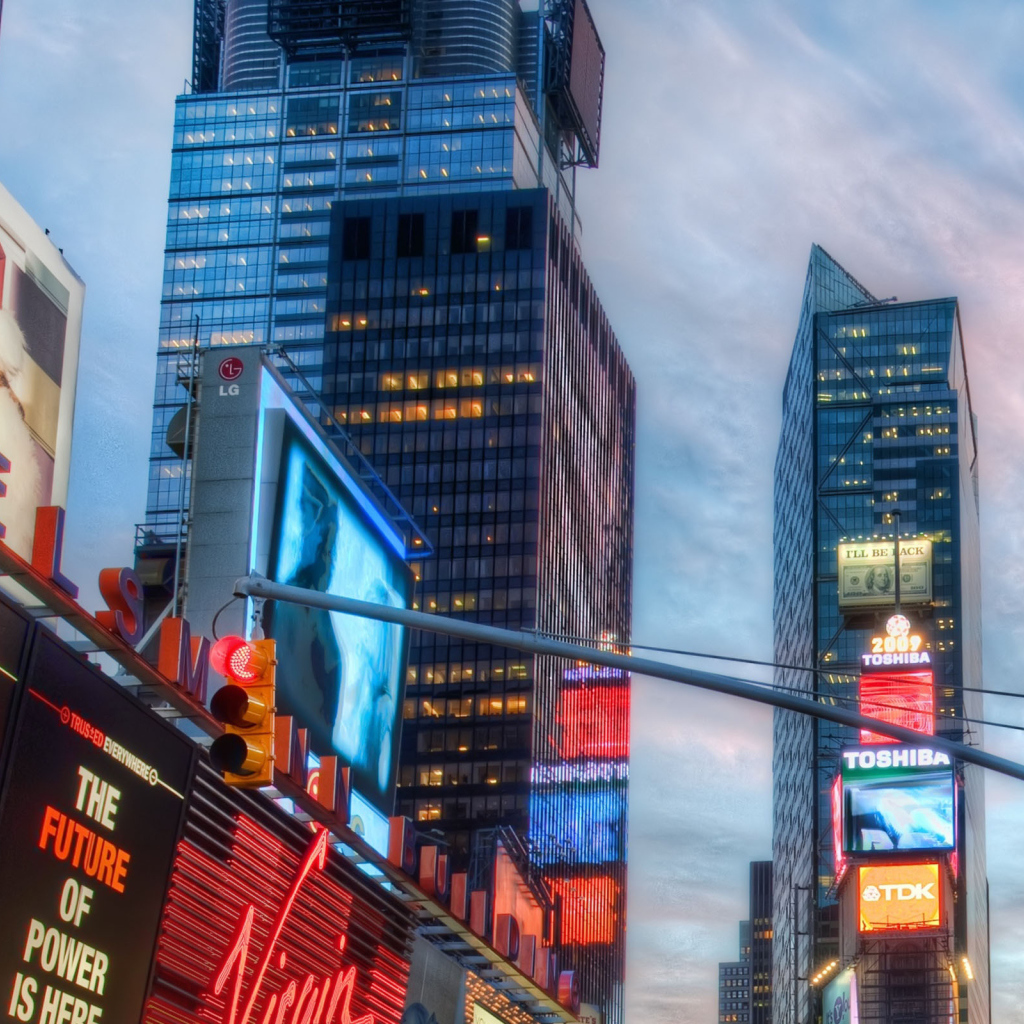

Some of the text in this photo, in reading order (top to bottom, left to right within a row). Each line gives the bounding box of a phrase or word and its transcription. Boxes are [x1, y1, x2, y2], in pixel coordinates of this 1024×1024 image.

[219, 384, 240, 396] LG
[846, 549, 868, 558] I'LL
[872, 548, 888, 557] BE
[862, 652, 930, 665] TOSHIBA
[872, 635, 922, 653] 2009
[103, 736, 150, 781] EVERYWHERE
[843, 749, 950, 768] TOSHIBA
[76, 765, 121, 831] THE
[38, 805, 131, 894] FUTURE
[59, 877, 94, 927] OF
[878, 883, 936, 900] TDK
[23, 918, 109, 996] POWER
[8, 972, 37, 1022] IS
